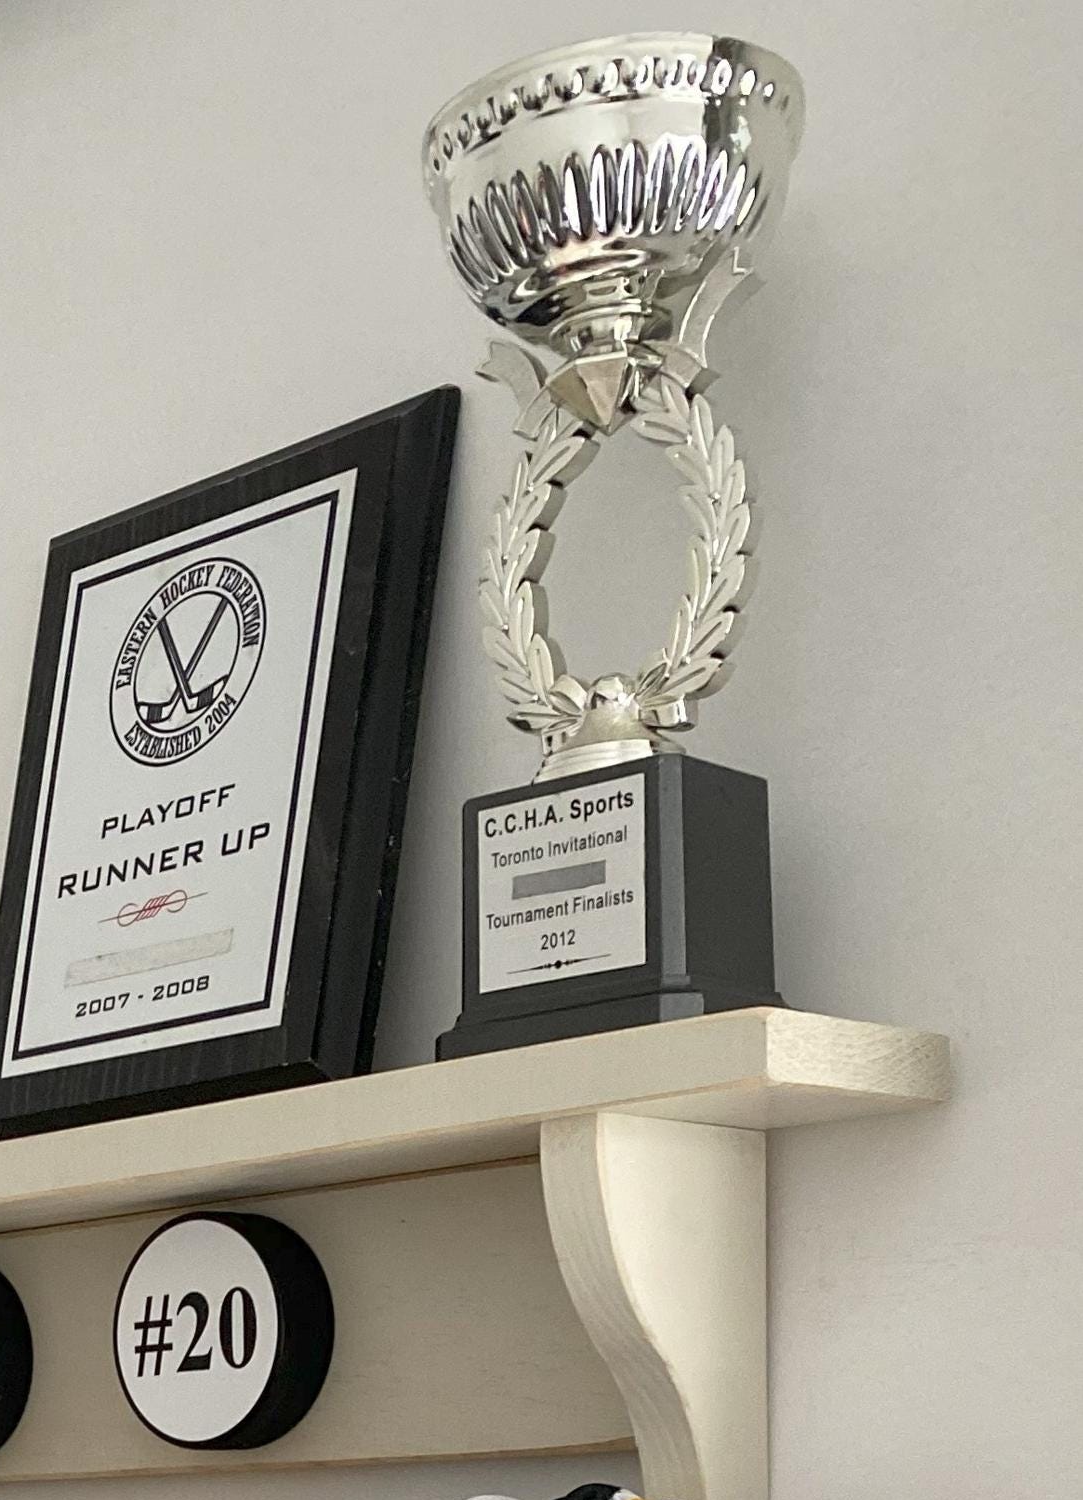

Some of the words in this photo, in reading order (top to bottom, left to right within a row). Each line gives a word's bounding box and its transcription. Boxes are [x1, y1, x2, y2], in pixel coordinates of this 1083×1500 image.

[116, 606, 158, 690] EASTERN
[159, 563, 215, 611] HOCKEY
[216, 564, 262, 649] FEDERATION
[124, 720, 202, 759] ESTABLISHED
[204, 692, 237, 735] 2004
[101, 783, 236, 839] PLAYOFF
[484, 804, 564, 838] C.C.H.A.
[570, 790, 634, 822] Sports
[57, 840, 204, 899] RUNNER
[220, 822, 270, 857] UP
[491, 845, 544, 869] Toronto
[548, 825, 628, 857] Invitational
[486, 901, 569, 930] Tournament
[572, 888, 634, 914] Finalists
[540, 929, 576, 950] 2012
[75, 992, 130, 1018] 2007
[152, 975, 211, 1001] 2008
[134, 1286, 257, 1378] #20
